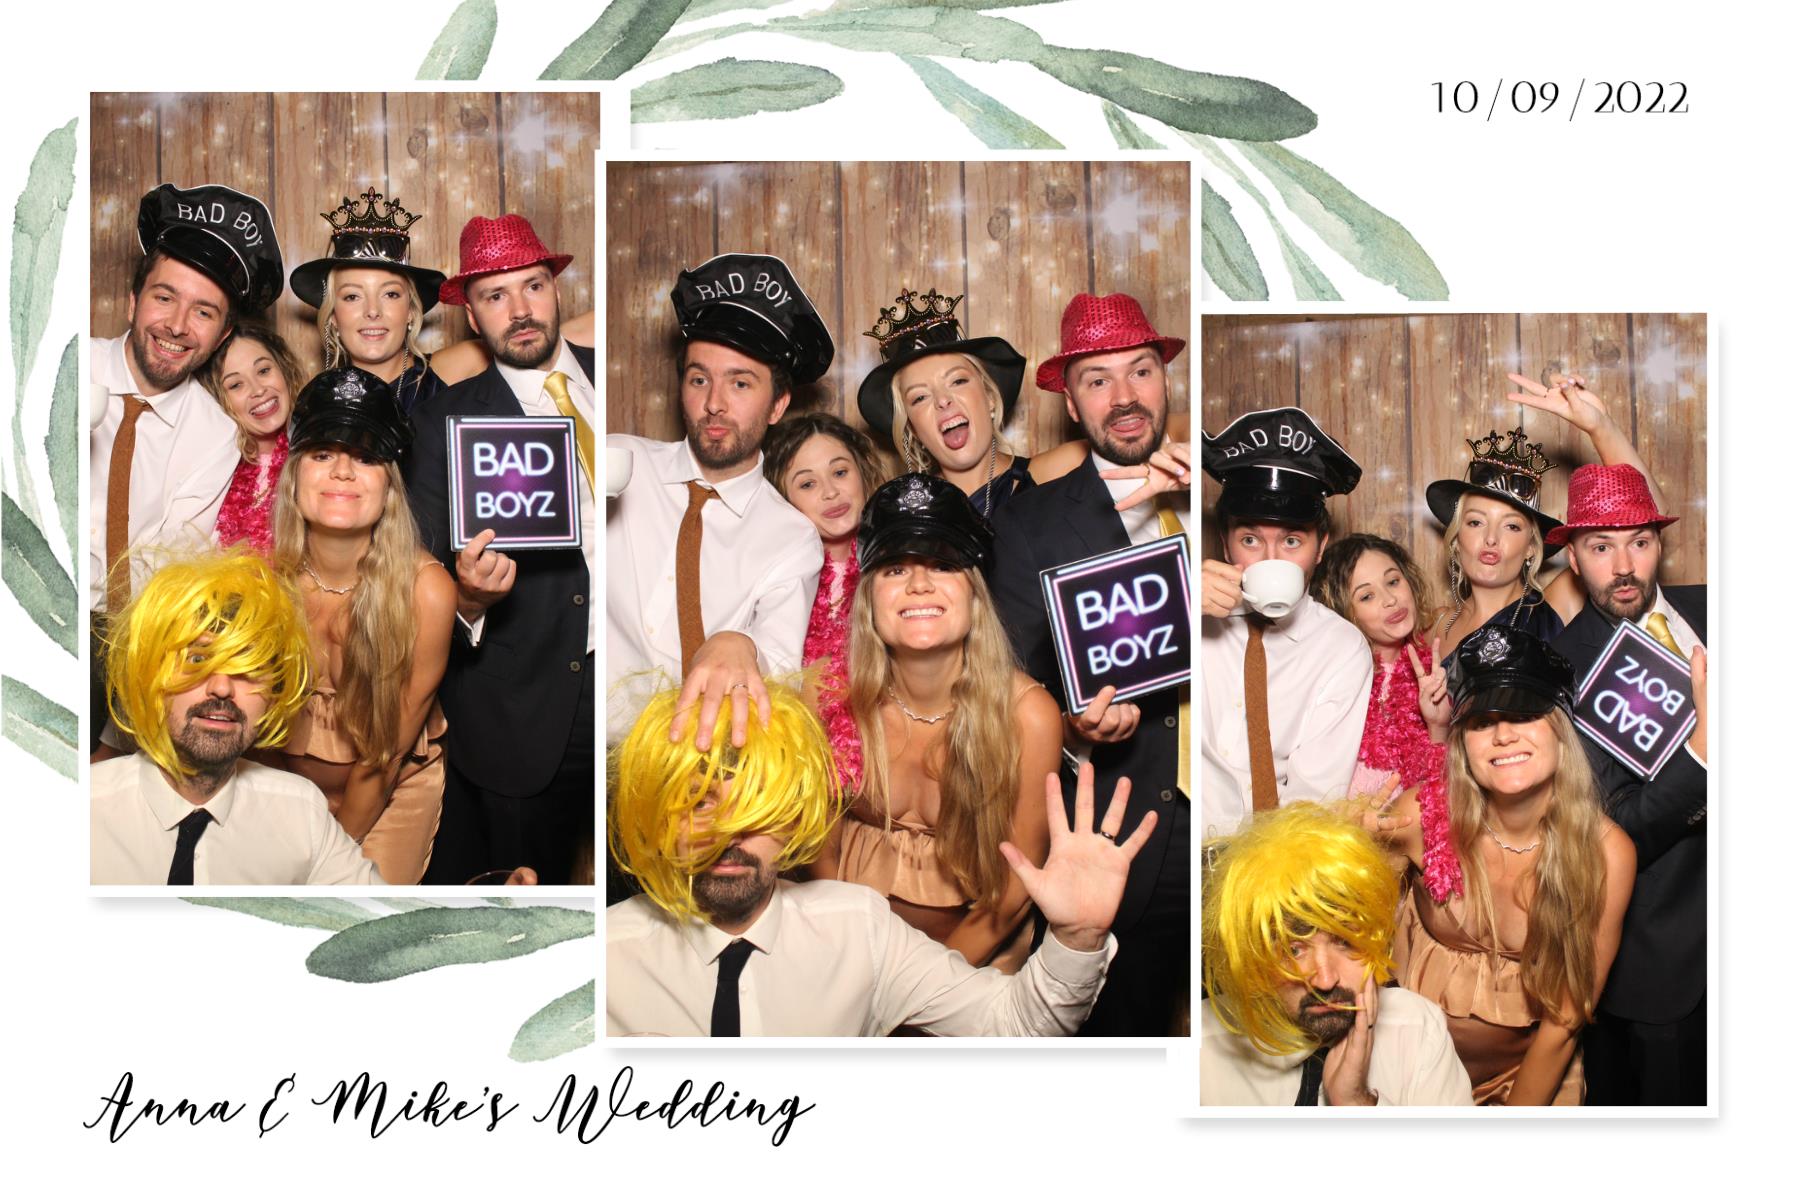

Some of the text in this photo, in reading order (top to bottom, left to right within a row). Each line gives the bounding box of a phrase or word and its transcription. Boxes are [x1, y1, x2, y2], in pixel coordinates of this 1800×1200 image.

[177, 202, 263, 247] BAD BOY
[696, 272, 792, 308] BAD BOY
[473, 441, 555, 477] BAD
[1223, 424, 1317, 459] BAD BOY
[475, 490, 556, 518] BOYZ
[1075, 573, 1169, 631] BAD
[1087, 623, 1179, 675] BOYZ
[1614, 655, 1686, 716] BOYZ
[1593, 689, 1664, 752] BAD
